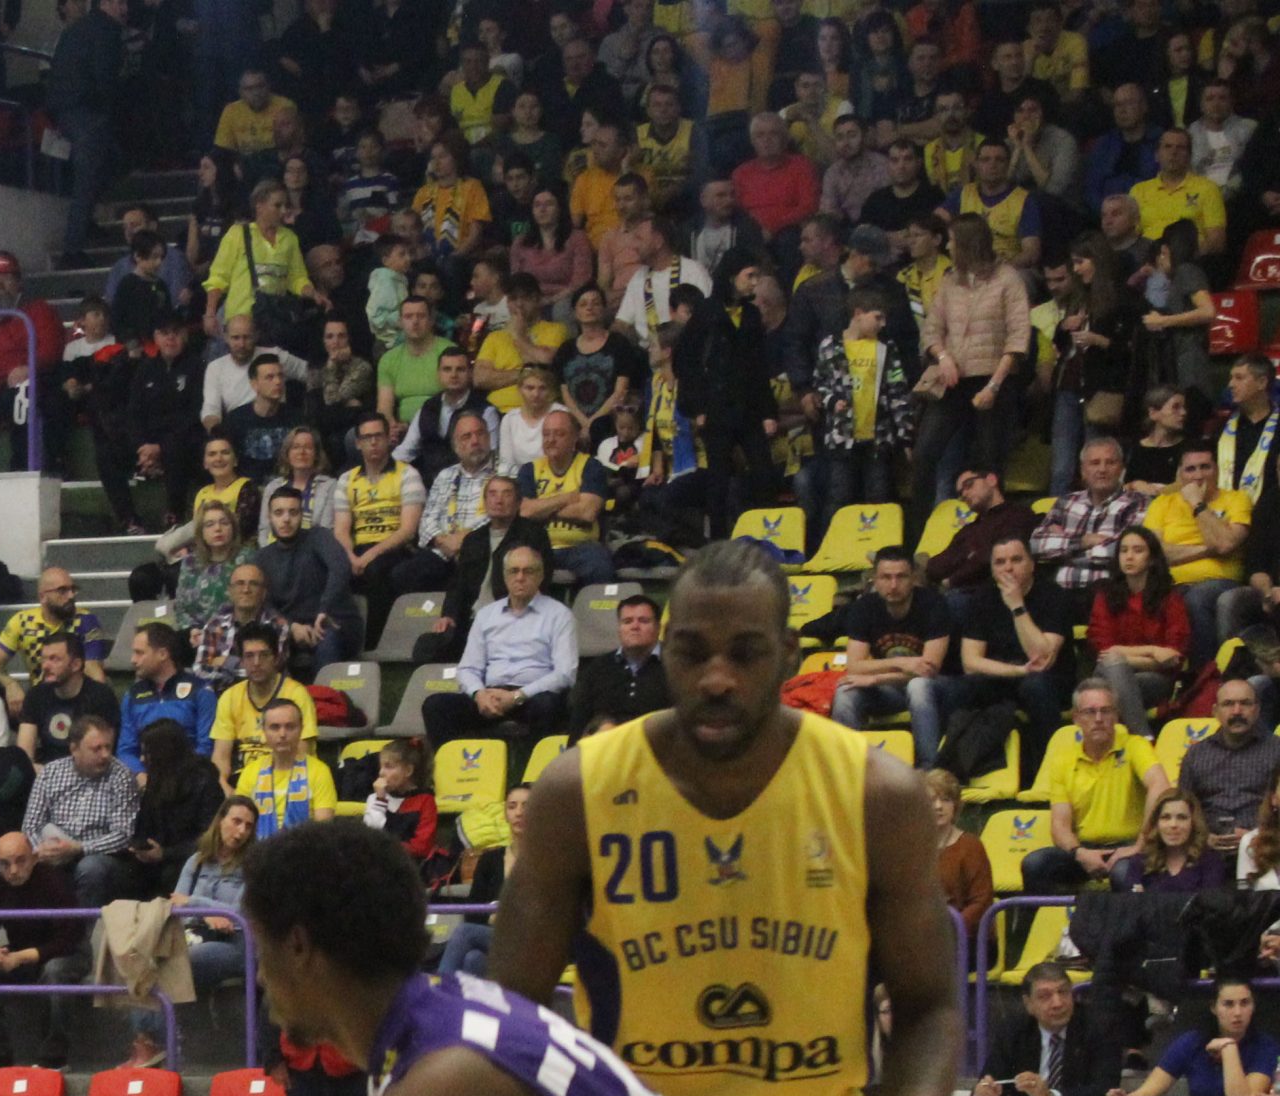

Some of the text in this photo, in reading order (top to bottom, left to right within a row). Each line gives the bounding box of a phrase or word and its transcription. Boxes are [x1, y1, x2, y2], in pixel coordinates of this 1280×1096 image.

[599, 830, 680, 905] 20
[621, 916, 839, 972] BC CSU SIBIU
[622, 1035, 842, 1081] compa
